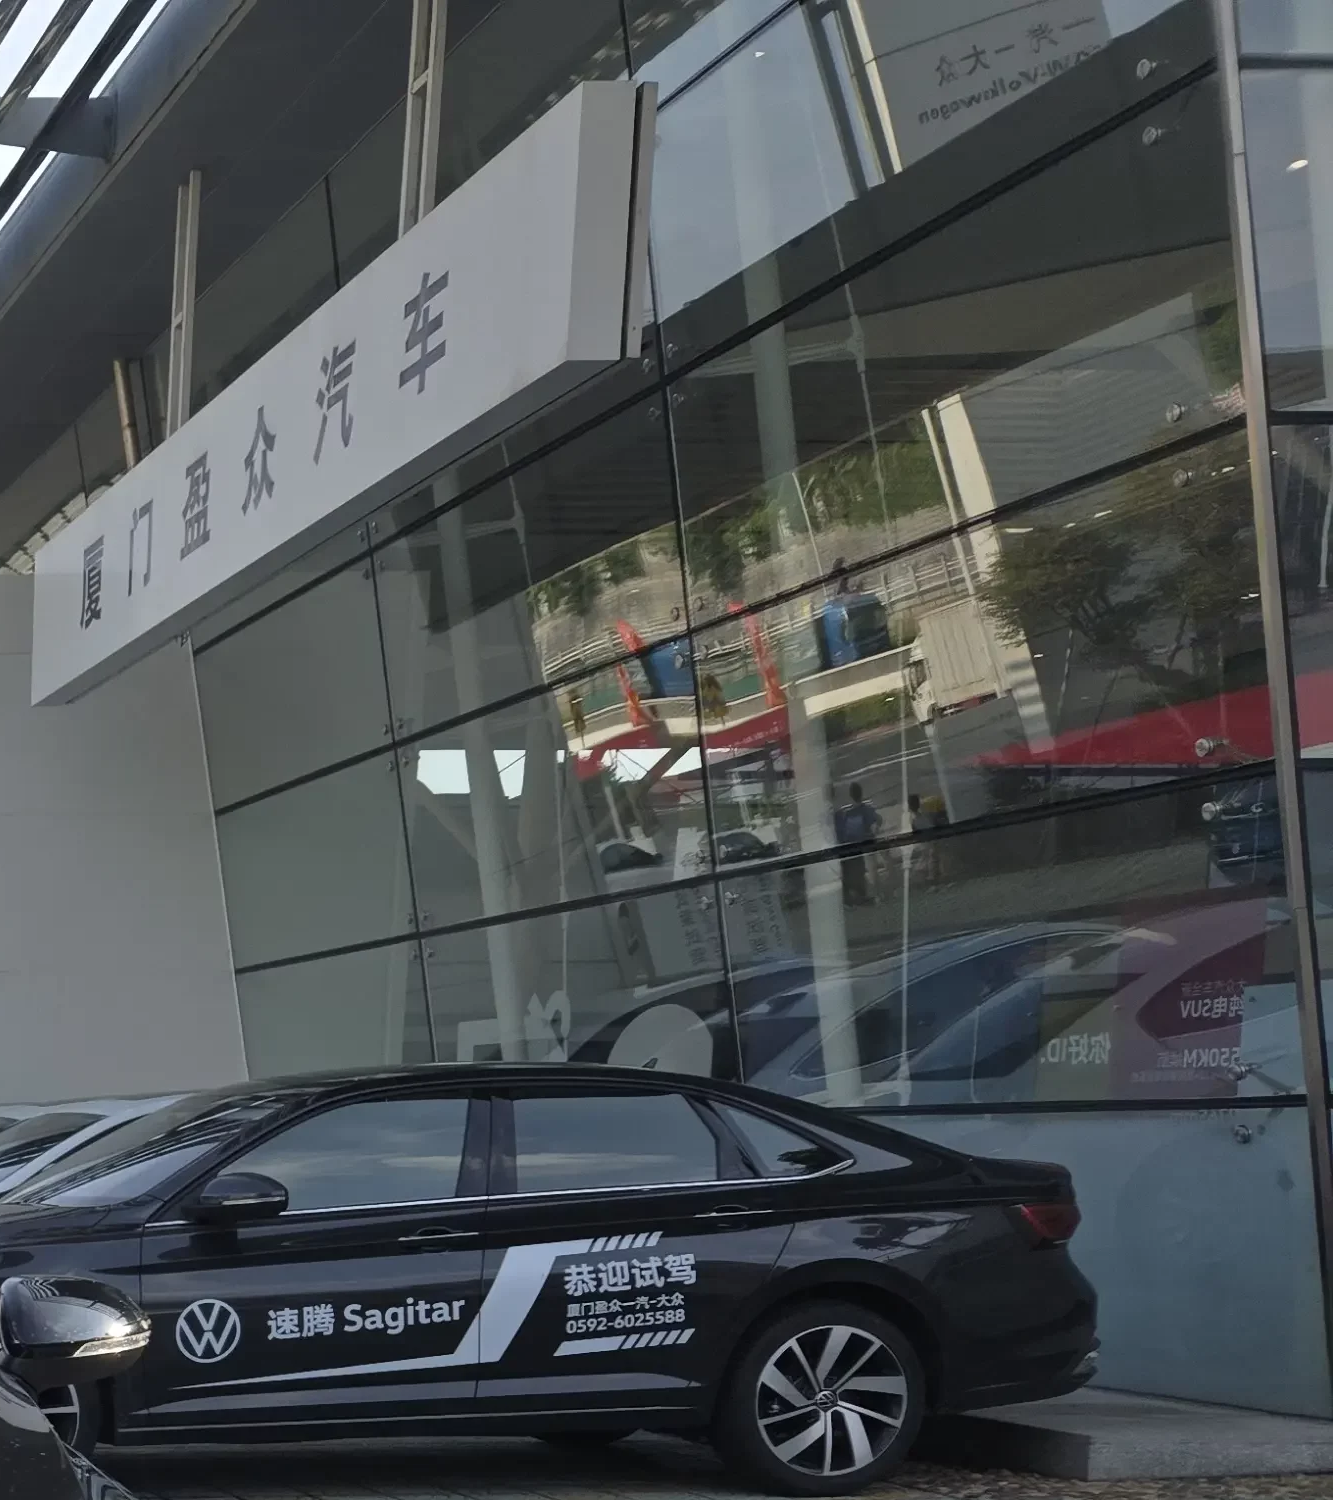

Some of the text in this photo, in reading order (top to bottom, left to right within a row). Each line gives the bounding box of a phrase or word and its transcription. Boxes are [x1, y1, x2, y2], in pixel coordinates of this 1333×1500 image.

[79, 270, 450, 631] 厦门盈众汽车
[563, 1253, 697, 1297] 恭迎试驾
[266, 1296, 465, 1341] 速腾 Sagitar
[565, 1308, 686, 1334] 0592-6025588
